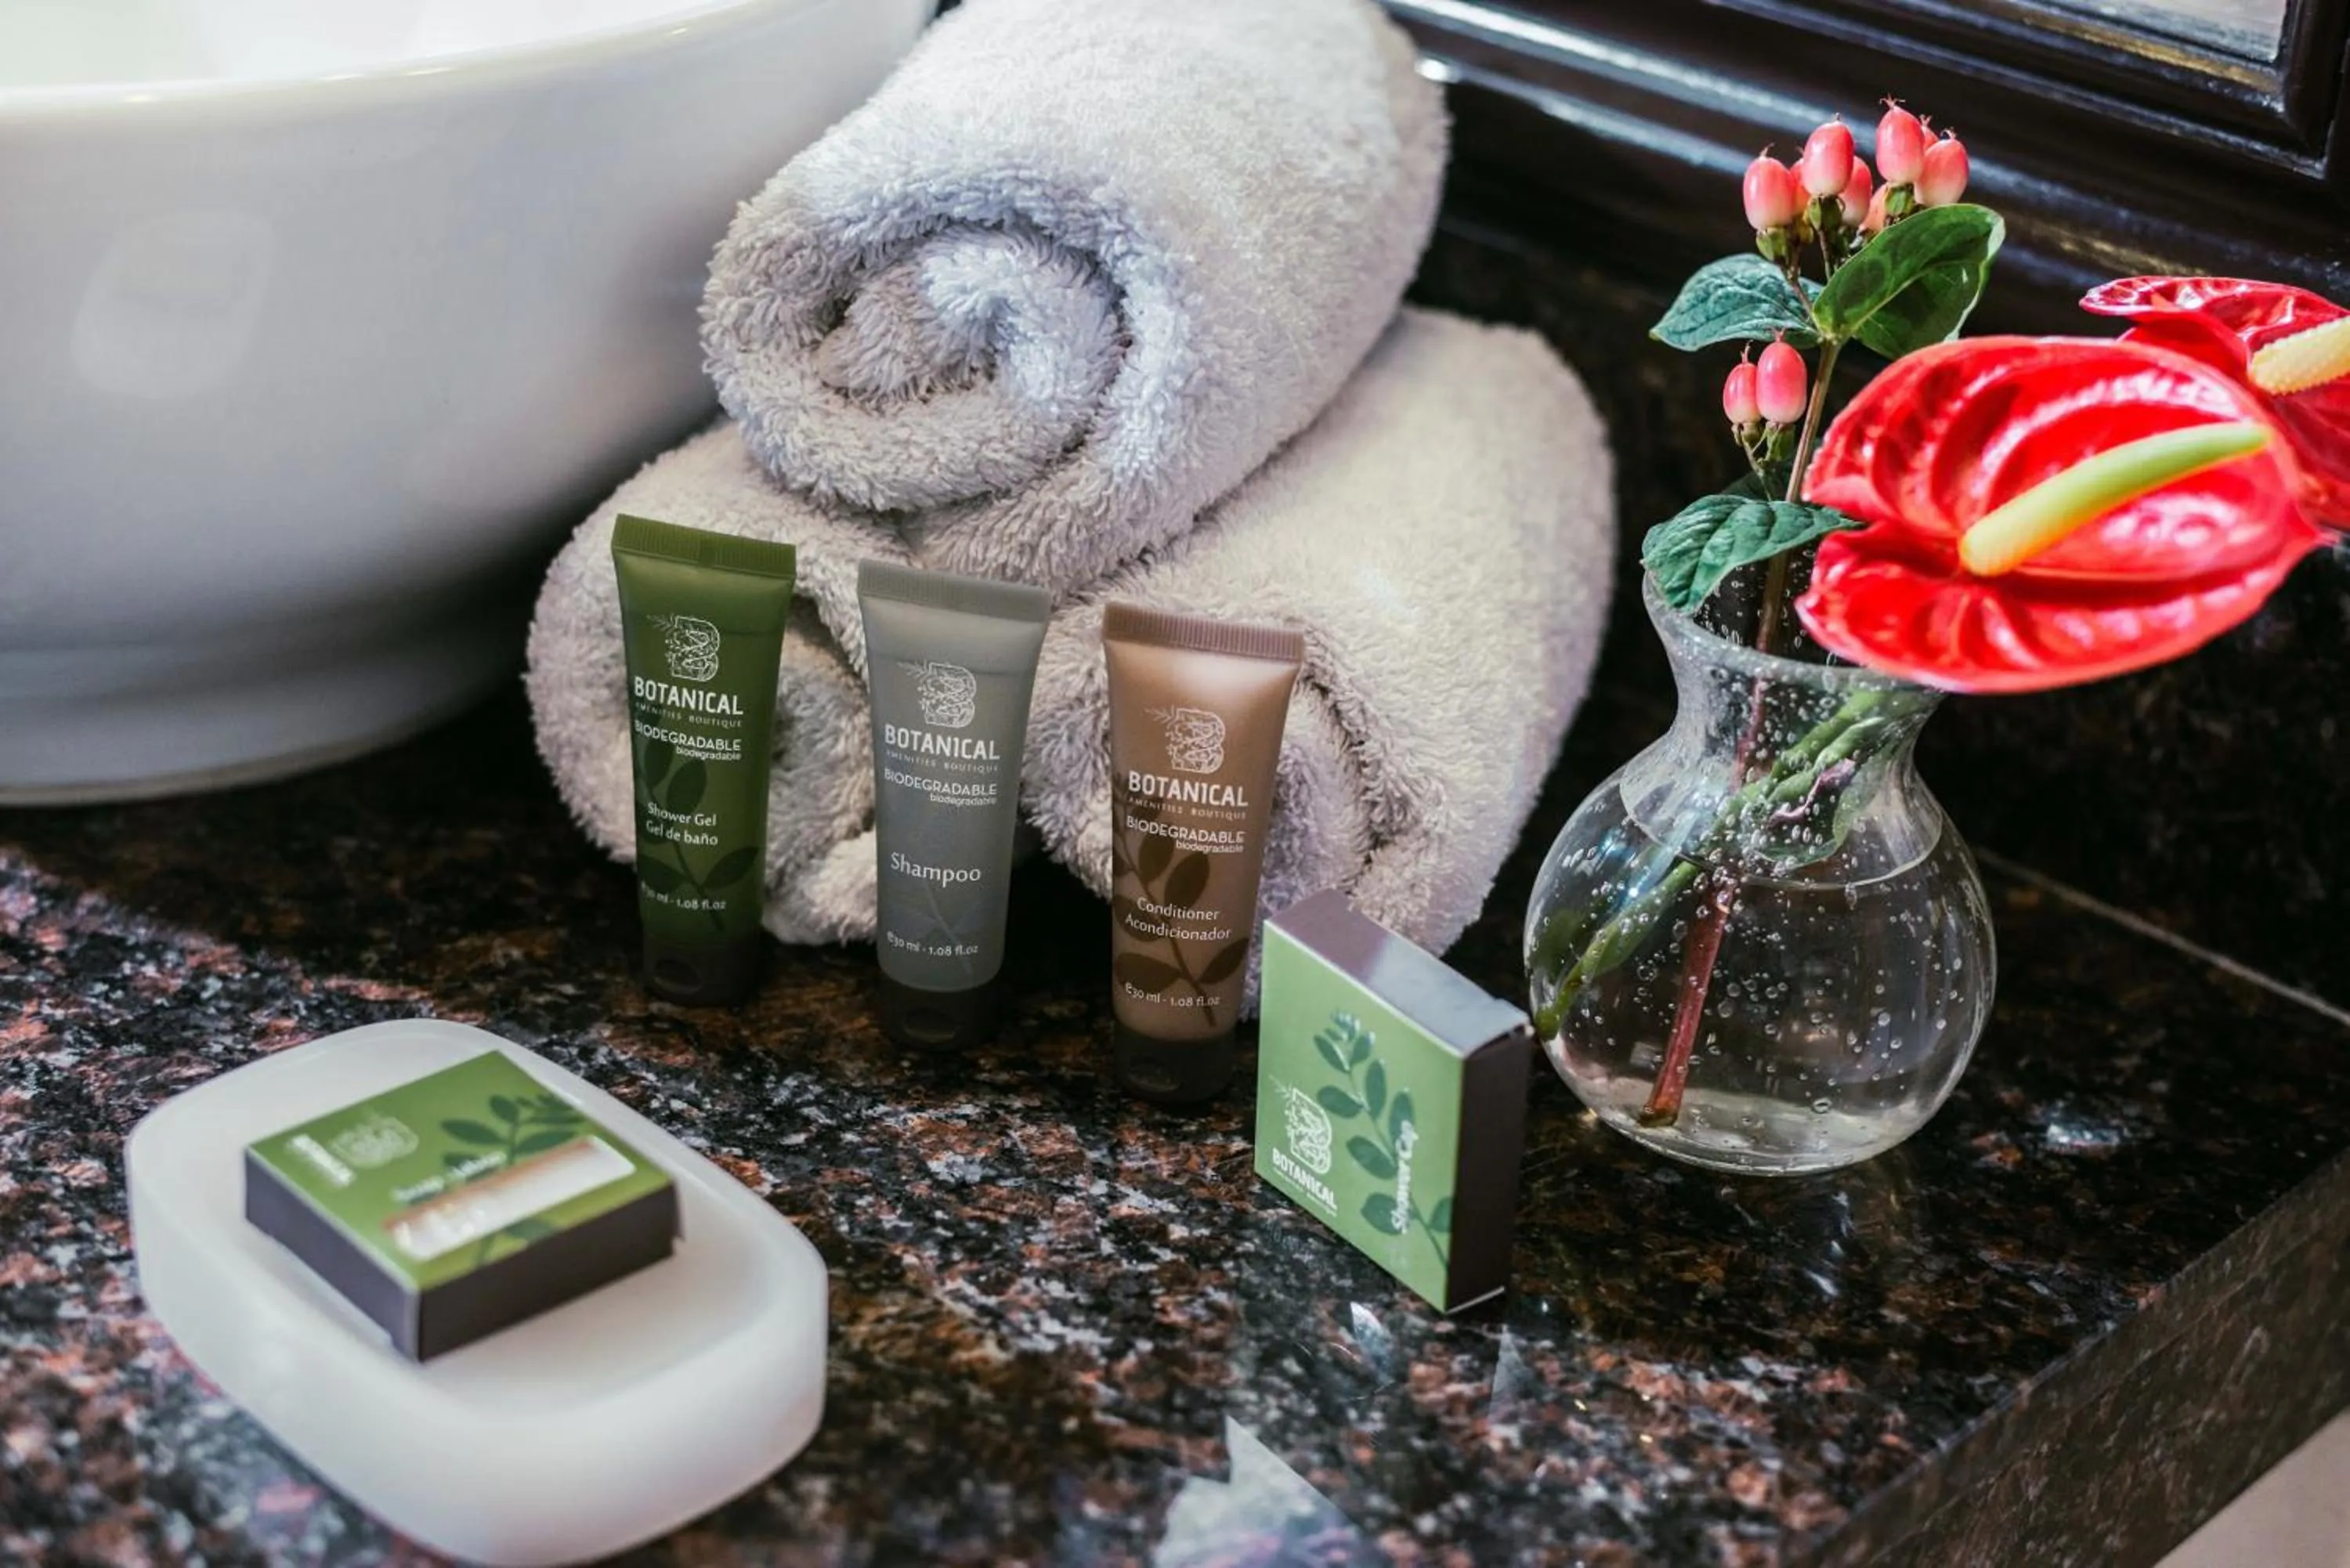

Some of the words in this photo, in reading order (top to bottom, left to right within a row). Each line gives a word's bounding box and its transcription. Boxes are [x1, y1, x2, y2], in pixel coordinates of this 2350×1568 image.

[634, 676, 744, 715] BOTANICAL
[634, 720, 743, 752] BIODEGRADABLE
[884, 723, 1001, 761] BOTANICAL
[884, 768, 997, 797] BIODEGRADABLE
[1128, 770, 1249, 807] BOTANICAL
[647, 802, 691, 824] Shower
[695, 814, 717, 826] Gel
[646, 821, 663, 836] Gel
[666, 827, 680, 841] de
[684, 831, 718, 845] baño
[1126, 815, 1247, 844] BIODEGRADABLE
[890, 851, 982, 889] Shampoo
[1137, 897, 1220, 921] Conditioner
[1125, 912, 1232, 940] Acondicionador
[928, 945, 953, 956] 1.08
[1146, 993, 1160, 1003] ml
[1170, 996, 1193, 1007] 1.08
[1272, 1147, 1338, 1211] BOTANICAL
